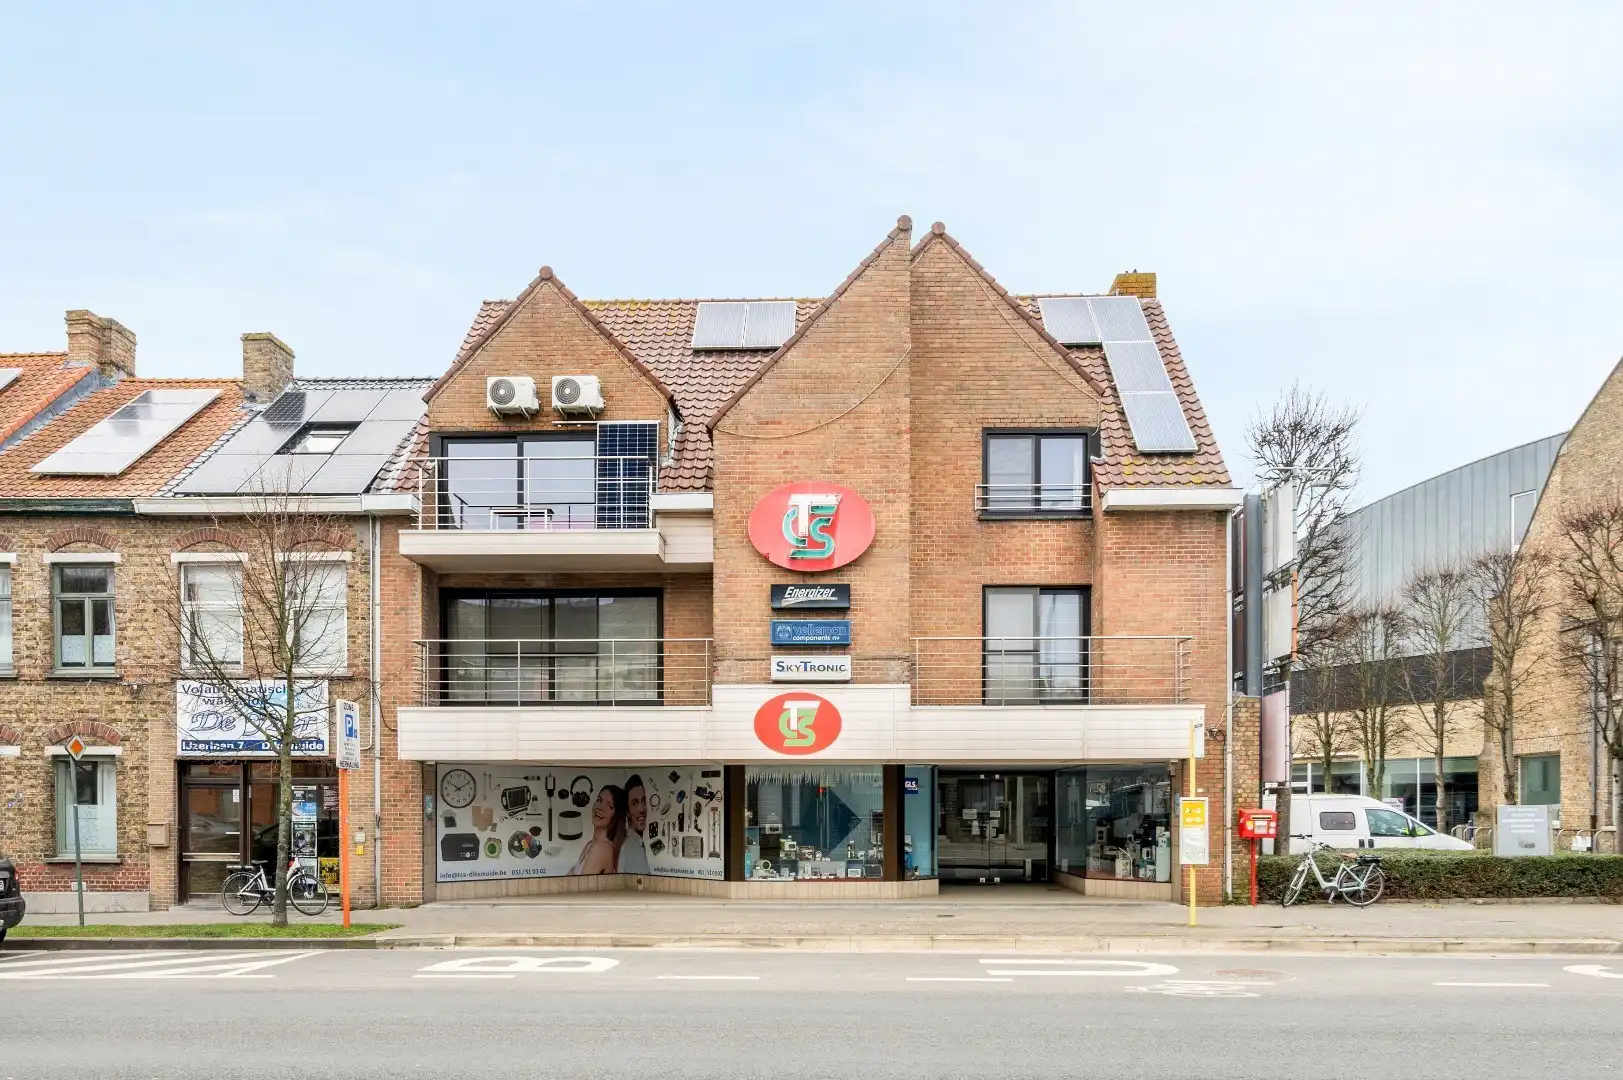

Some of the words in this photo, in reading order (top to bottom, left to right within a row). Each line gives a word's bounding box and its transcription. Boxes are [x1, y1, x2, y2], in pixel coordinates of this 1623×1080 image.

[784, 586, 835, 599] Energizer
[793, 624, 846, 635] velleman
[343, 702, 354, 711] ZONE
[190, 709, 236, 732] De
[237, 741, 244, 750] 7
[262, 741, 323, 750] Dkmuide
